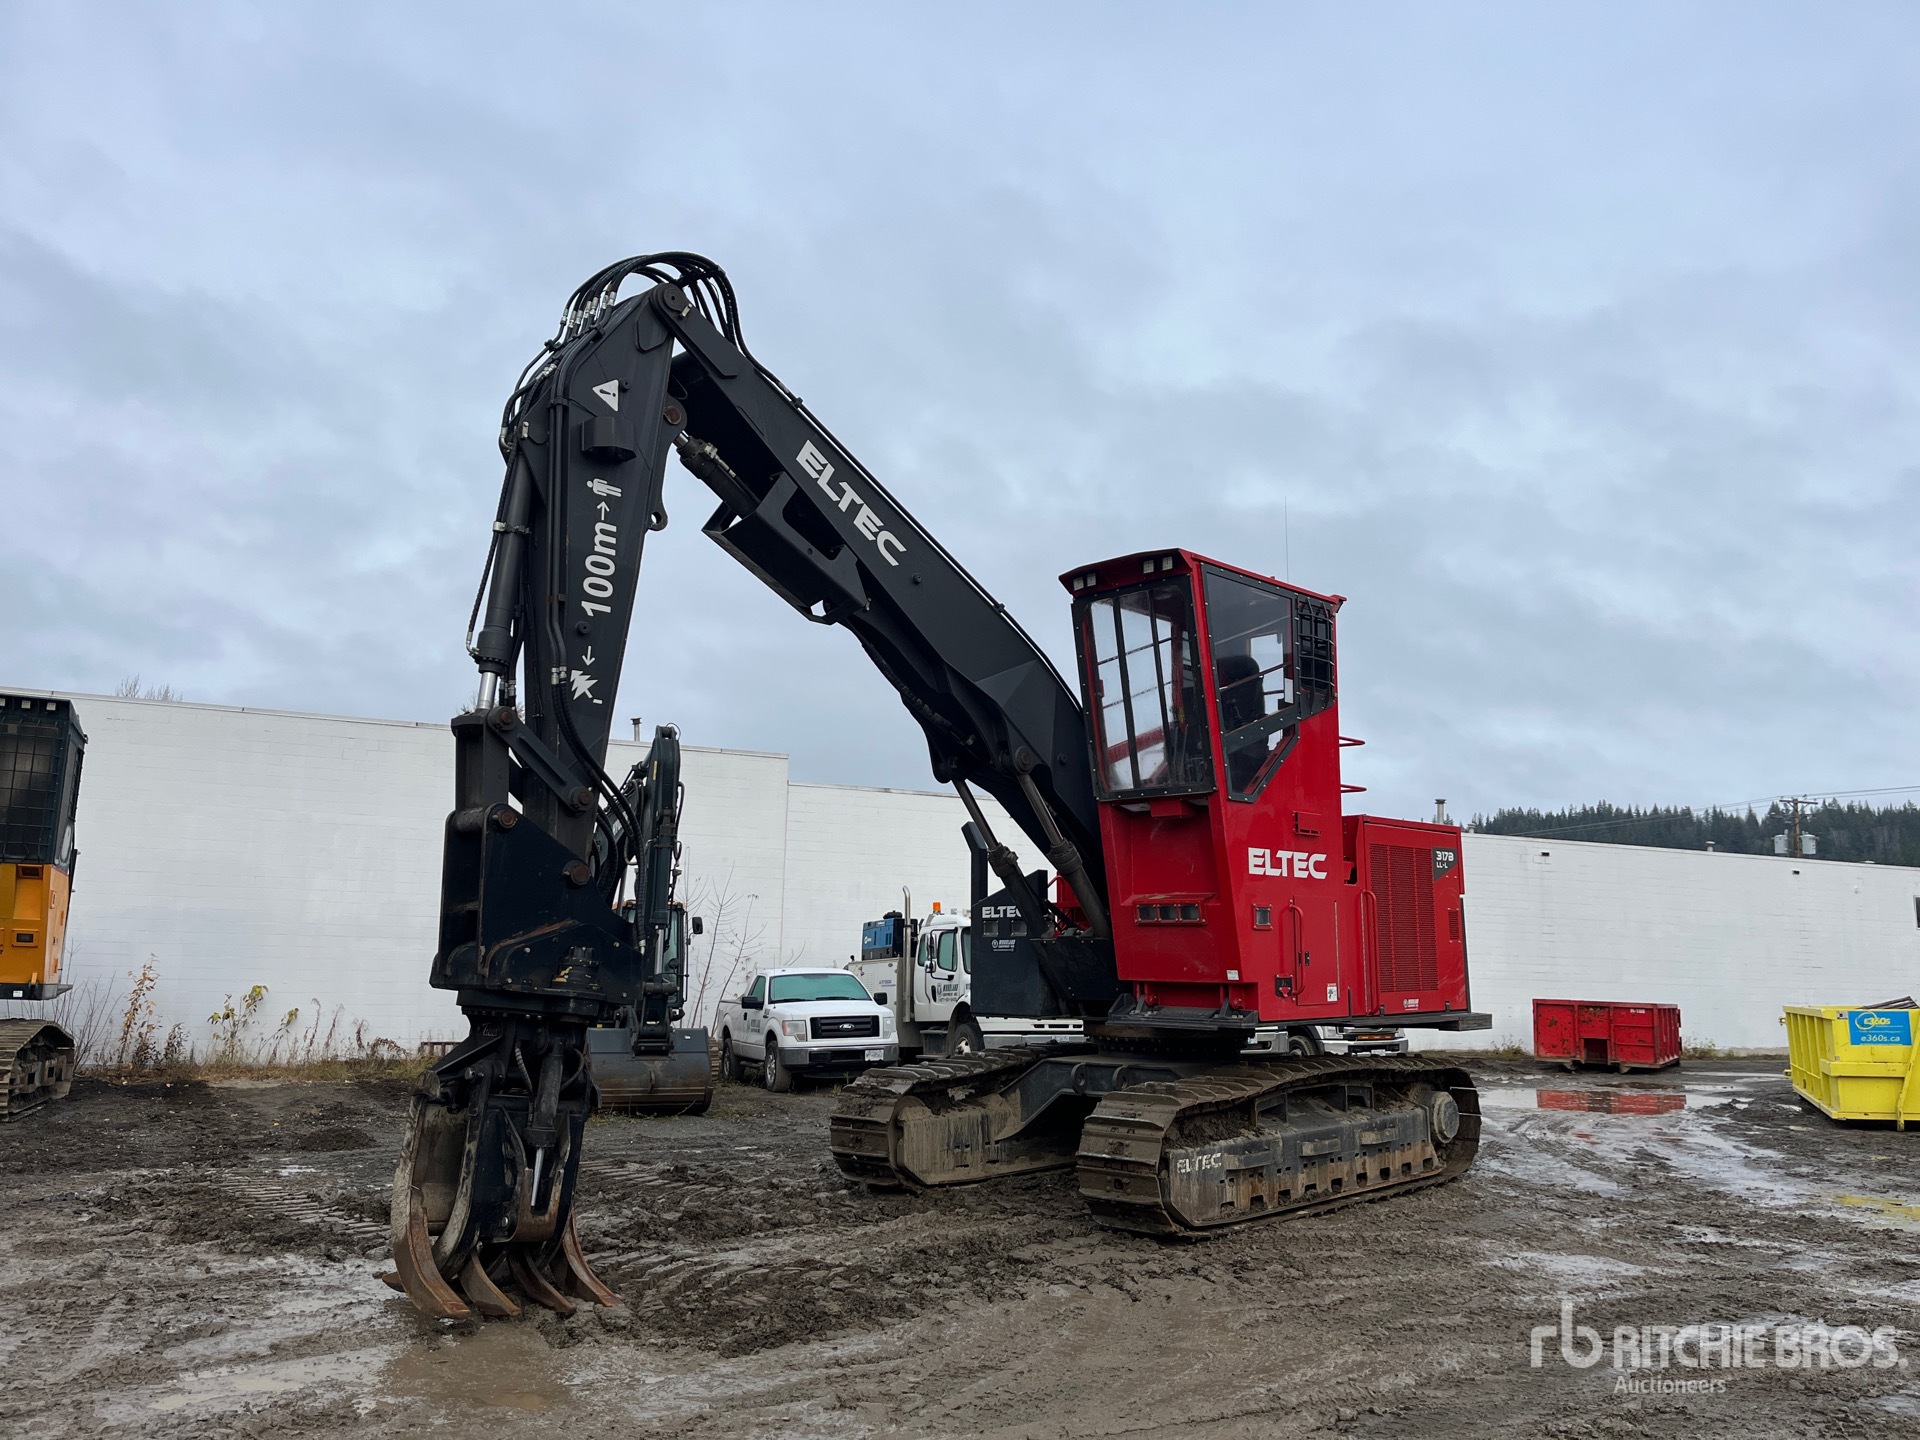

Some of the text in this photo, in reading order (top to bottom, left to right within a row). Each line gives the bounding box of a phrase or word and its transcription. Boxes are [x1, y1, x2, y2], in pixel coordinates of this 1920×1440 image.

[796, 440, 907, 566] ELTEC
[581, 522, 617, 617] 100m
[1248, 847, 1328, 880] ELTEC
[1860, 1034, 1900, 1042] e360s.ca
